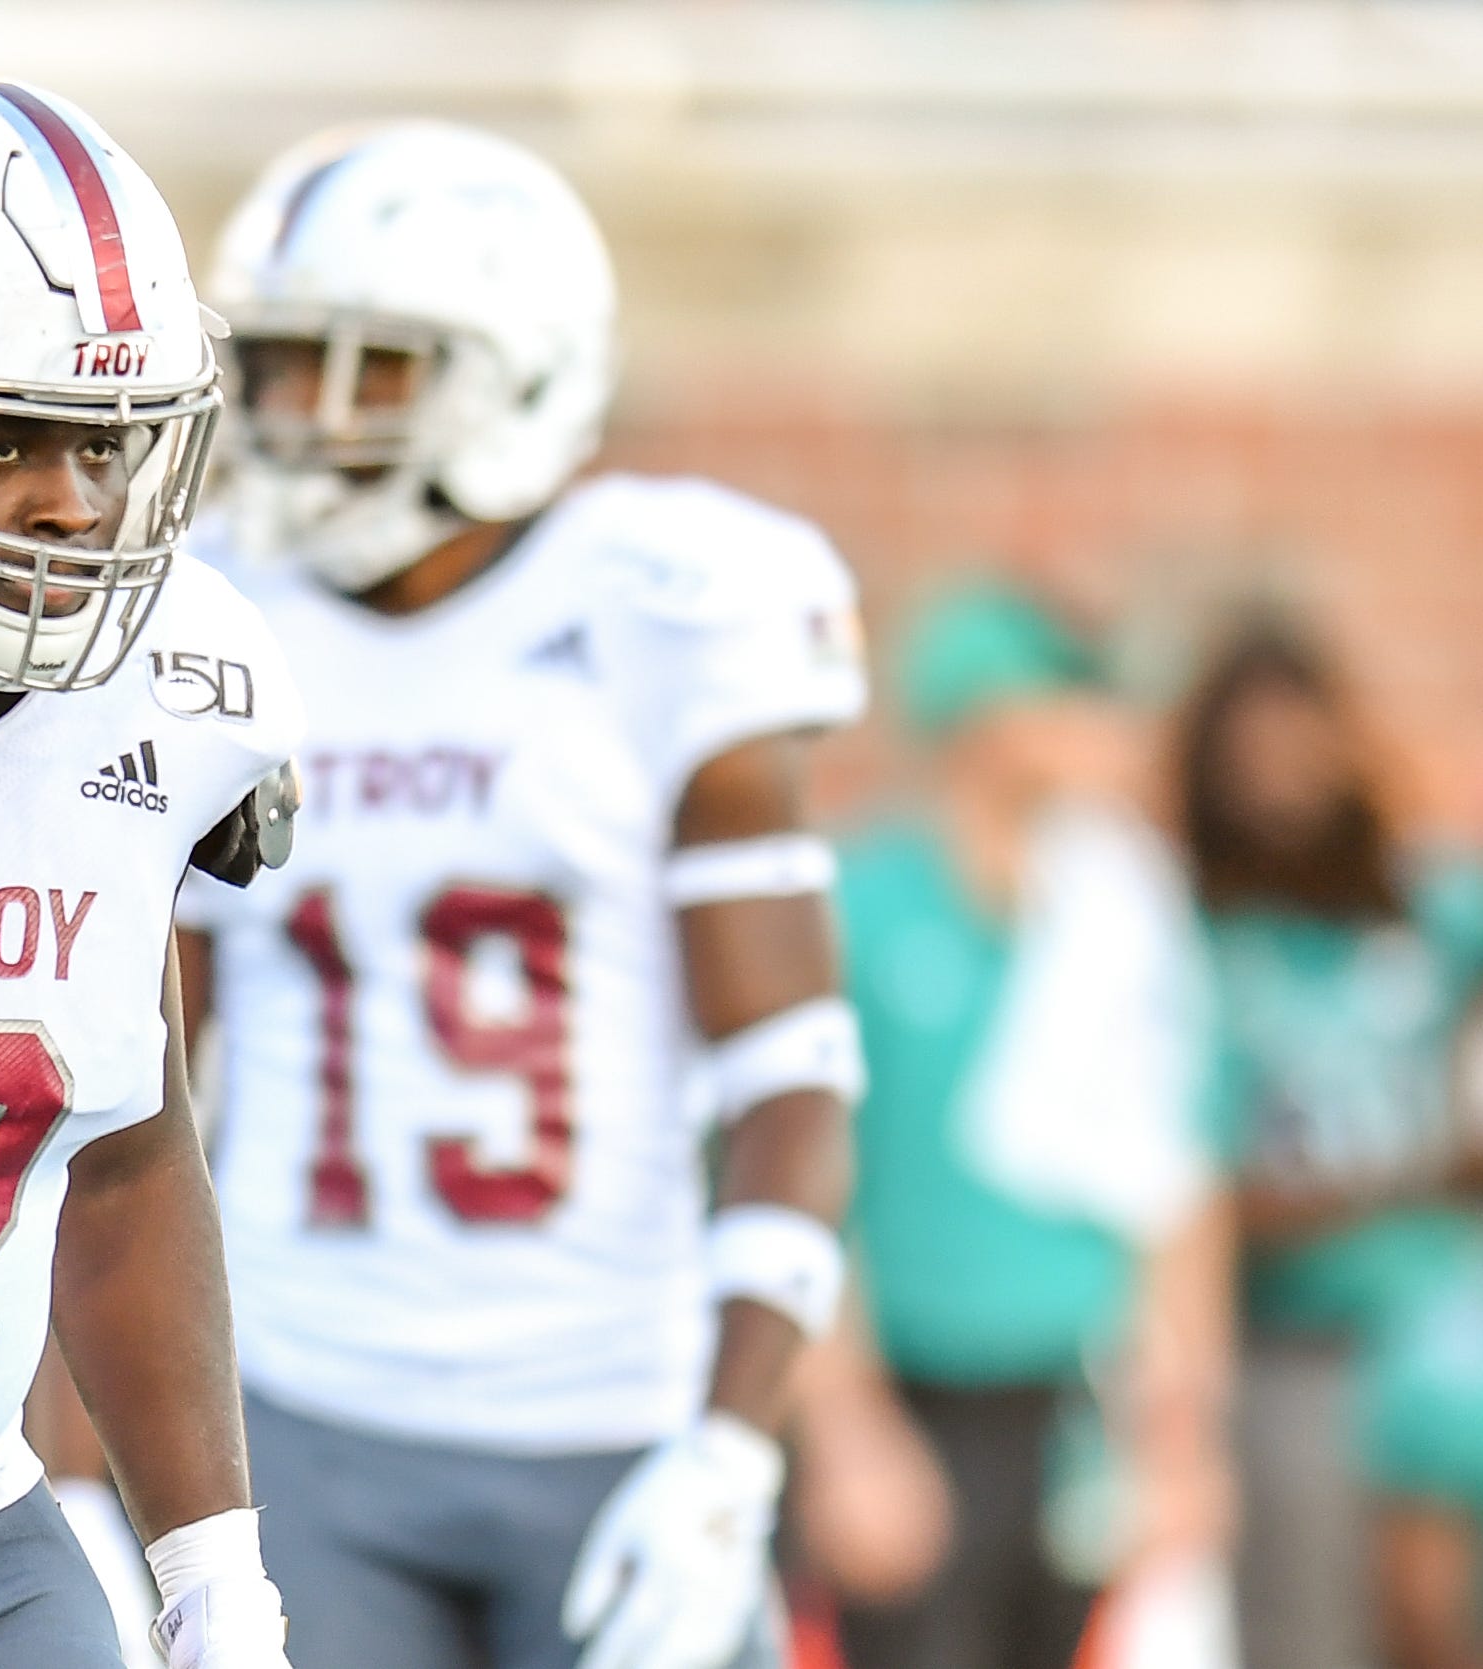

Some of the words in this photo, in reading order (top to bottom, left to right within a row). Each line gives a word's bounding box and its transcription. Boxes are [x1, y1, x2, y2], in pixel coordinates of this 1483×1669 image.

[73, 341, 149, 377] TROY
[148, 650, 254, 719] 150
[80, 777, 169, 814] adidas
[307, 744, 510, 822] TROY
[287, 882, 576, 1234] 19
